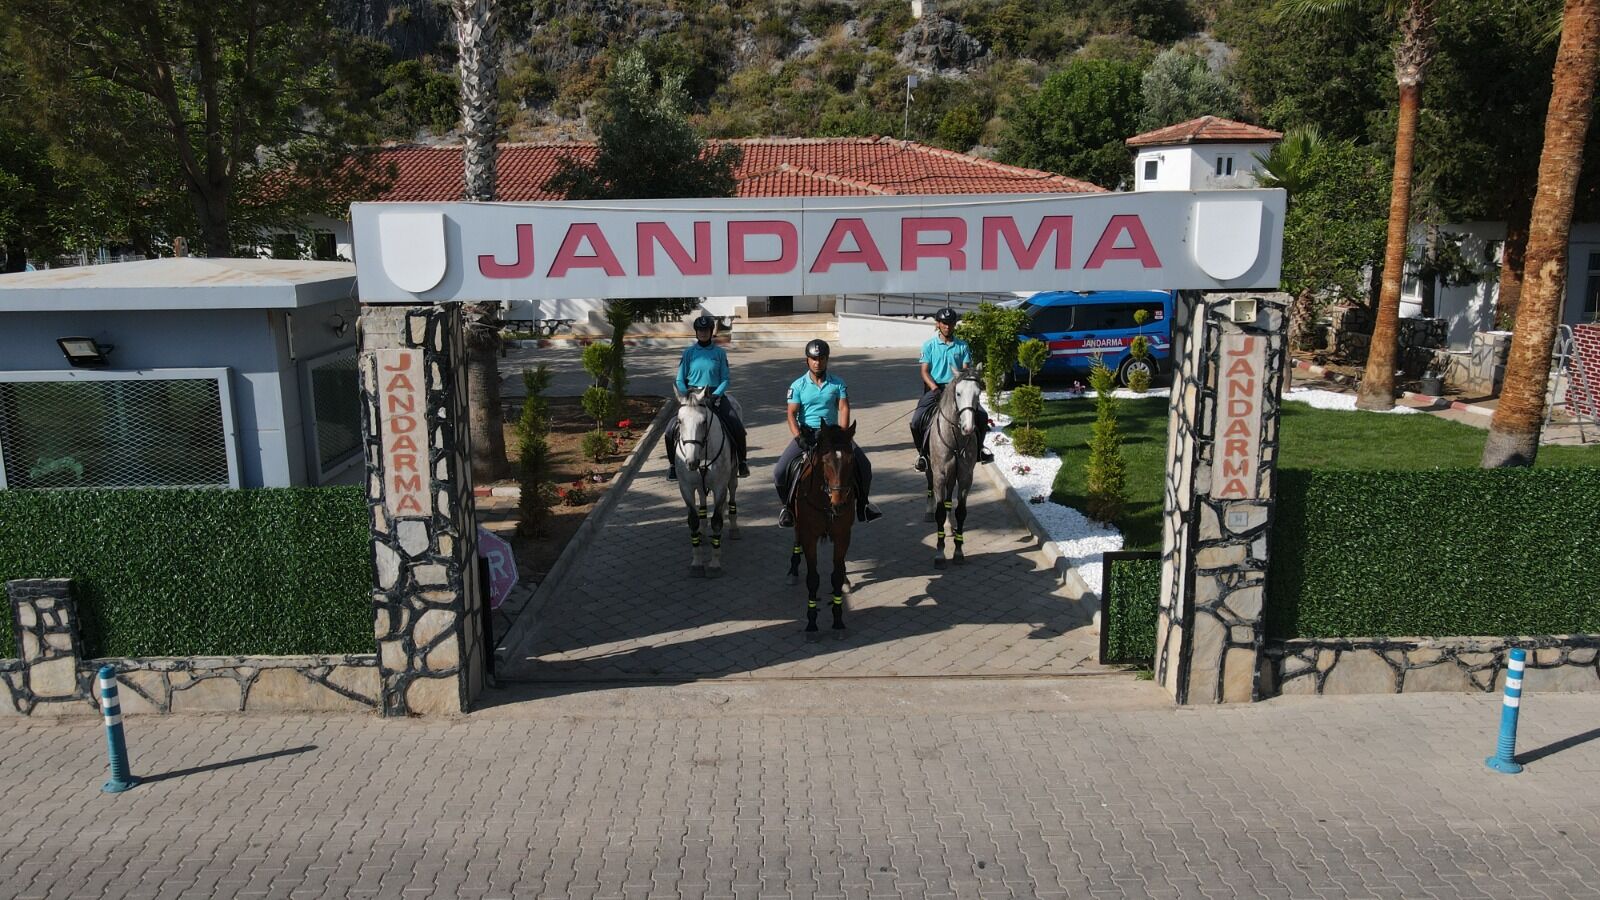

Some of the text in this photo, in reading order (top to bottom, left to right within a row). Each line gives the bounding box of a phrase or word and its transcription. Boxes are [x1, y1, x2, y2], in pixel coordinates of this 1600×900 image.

[478, 214, 1163, 279] JANDARMA
[1081, 338, 1124, 348] JANDARMA
[384, 352, 423, 514] JANDARMA
[1219, 337, 1256, 498] JANDARMA
